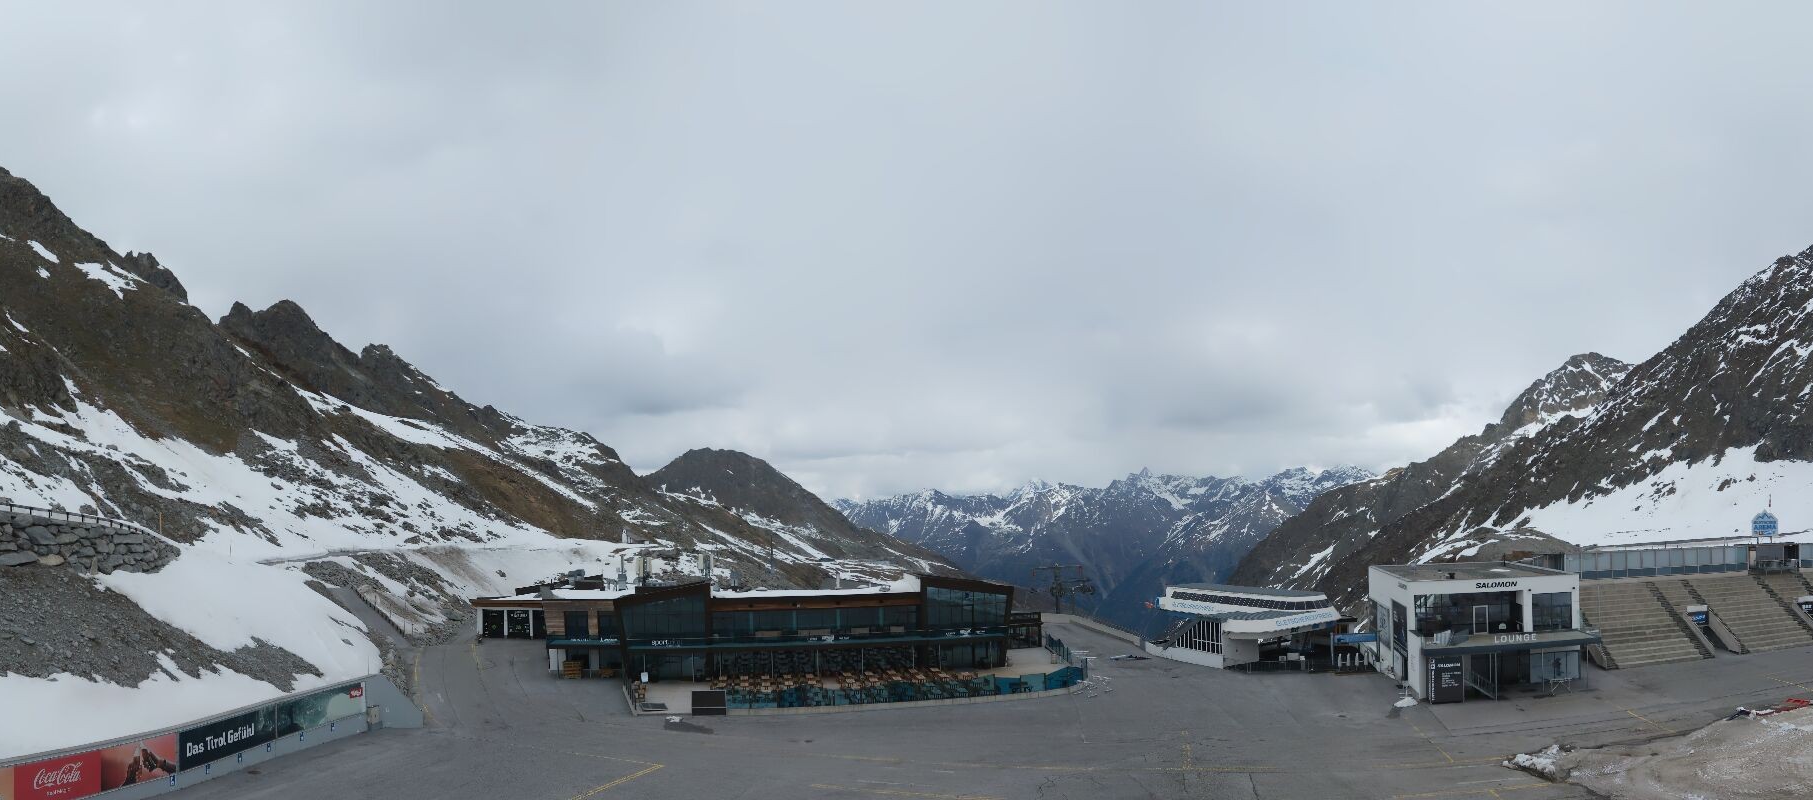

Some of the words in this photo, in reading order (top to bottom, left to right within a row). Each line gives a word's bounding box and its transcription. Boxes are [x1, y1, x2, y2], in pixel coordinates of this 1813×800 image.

[1475, 581, 1518, 589] SALOMON
[1494, 633, 1537, 644] LOUNGE
[186, 742, 204, 757] Das
[205, 731, 227, 751] Tirol
[227, 722, 255, 743] Gefühl
[33, 761, 84, 790] Coca-Cola
